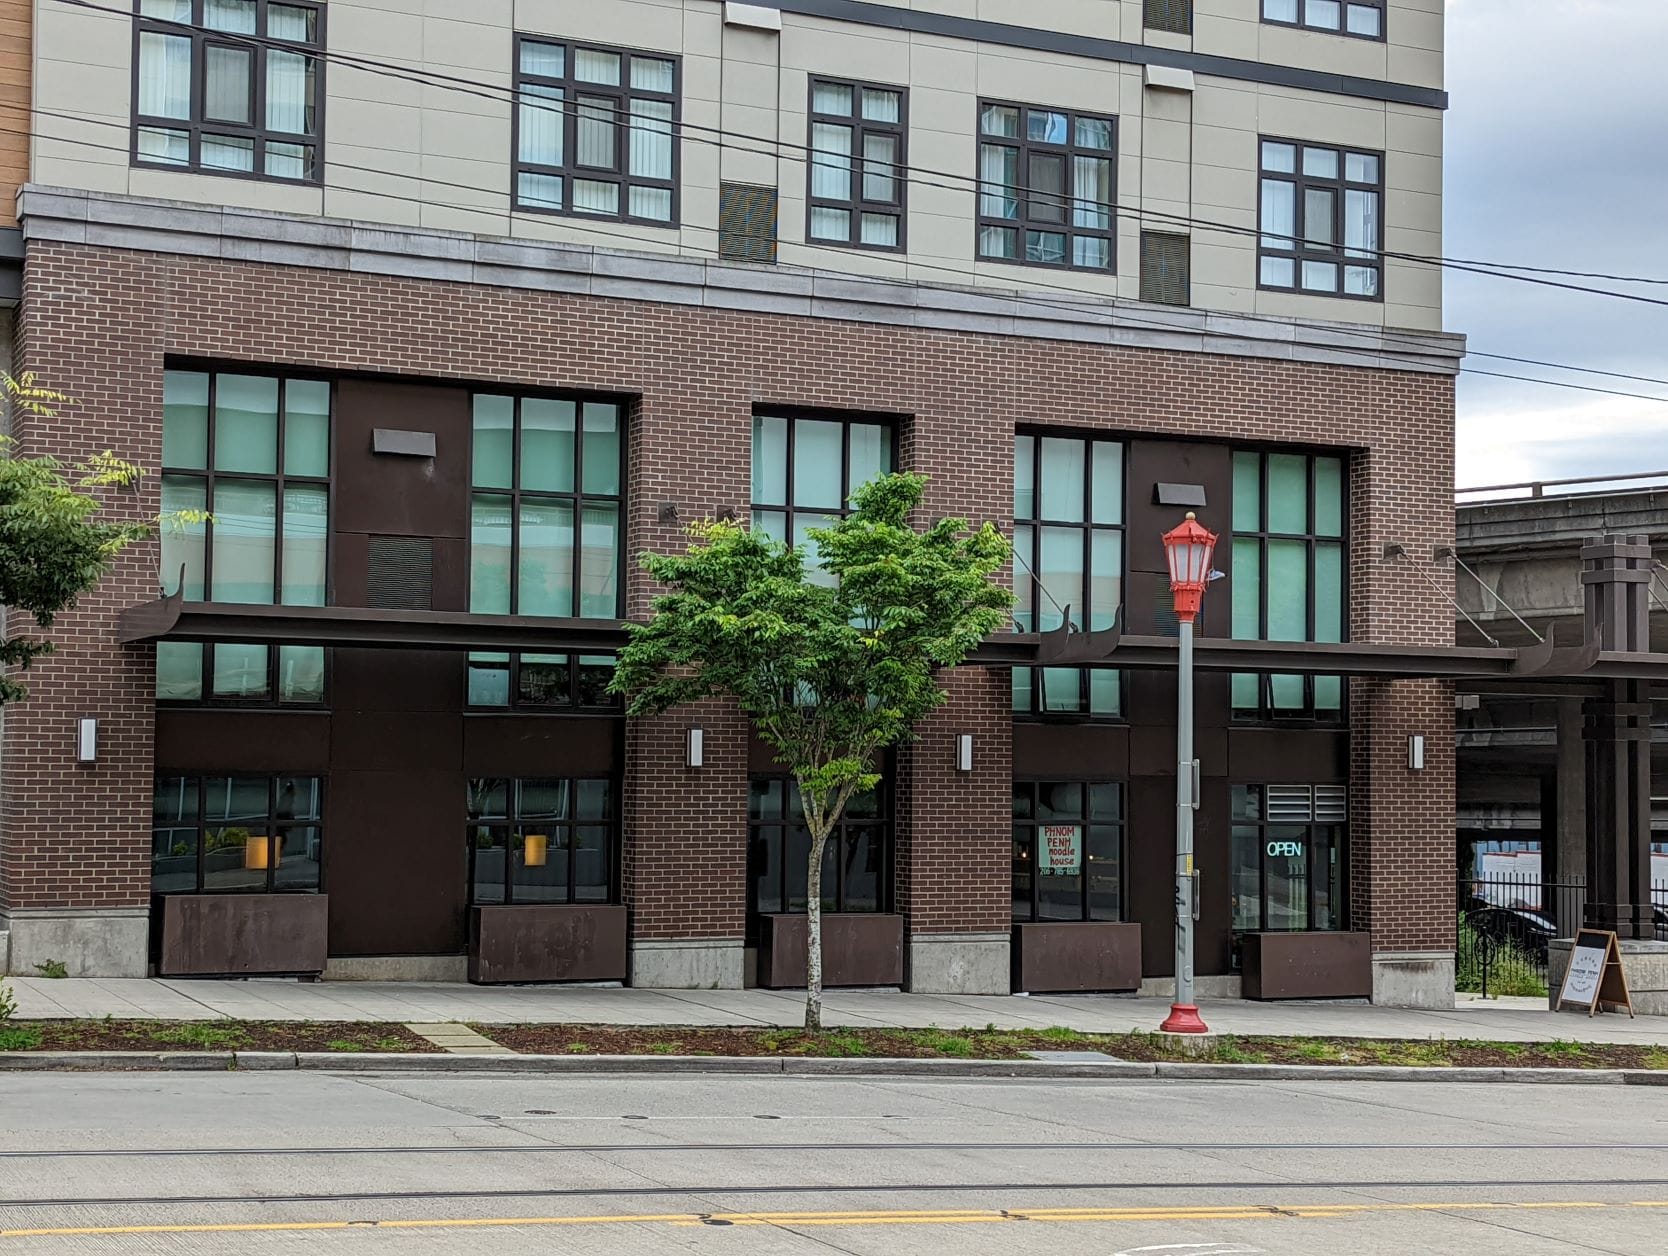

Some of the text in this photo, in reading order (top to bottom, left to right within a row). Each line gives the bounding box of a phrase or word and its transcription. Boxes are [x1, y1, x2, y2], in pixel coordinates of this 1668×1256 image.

[1044, 826, 1075, 837] PHNOM
[1047, 837, 1071, 847] PENH
[1267, 841, 1302, 857] OPEN
[1050, 857, 1075, 866] house
